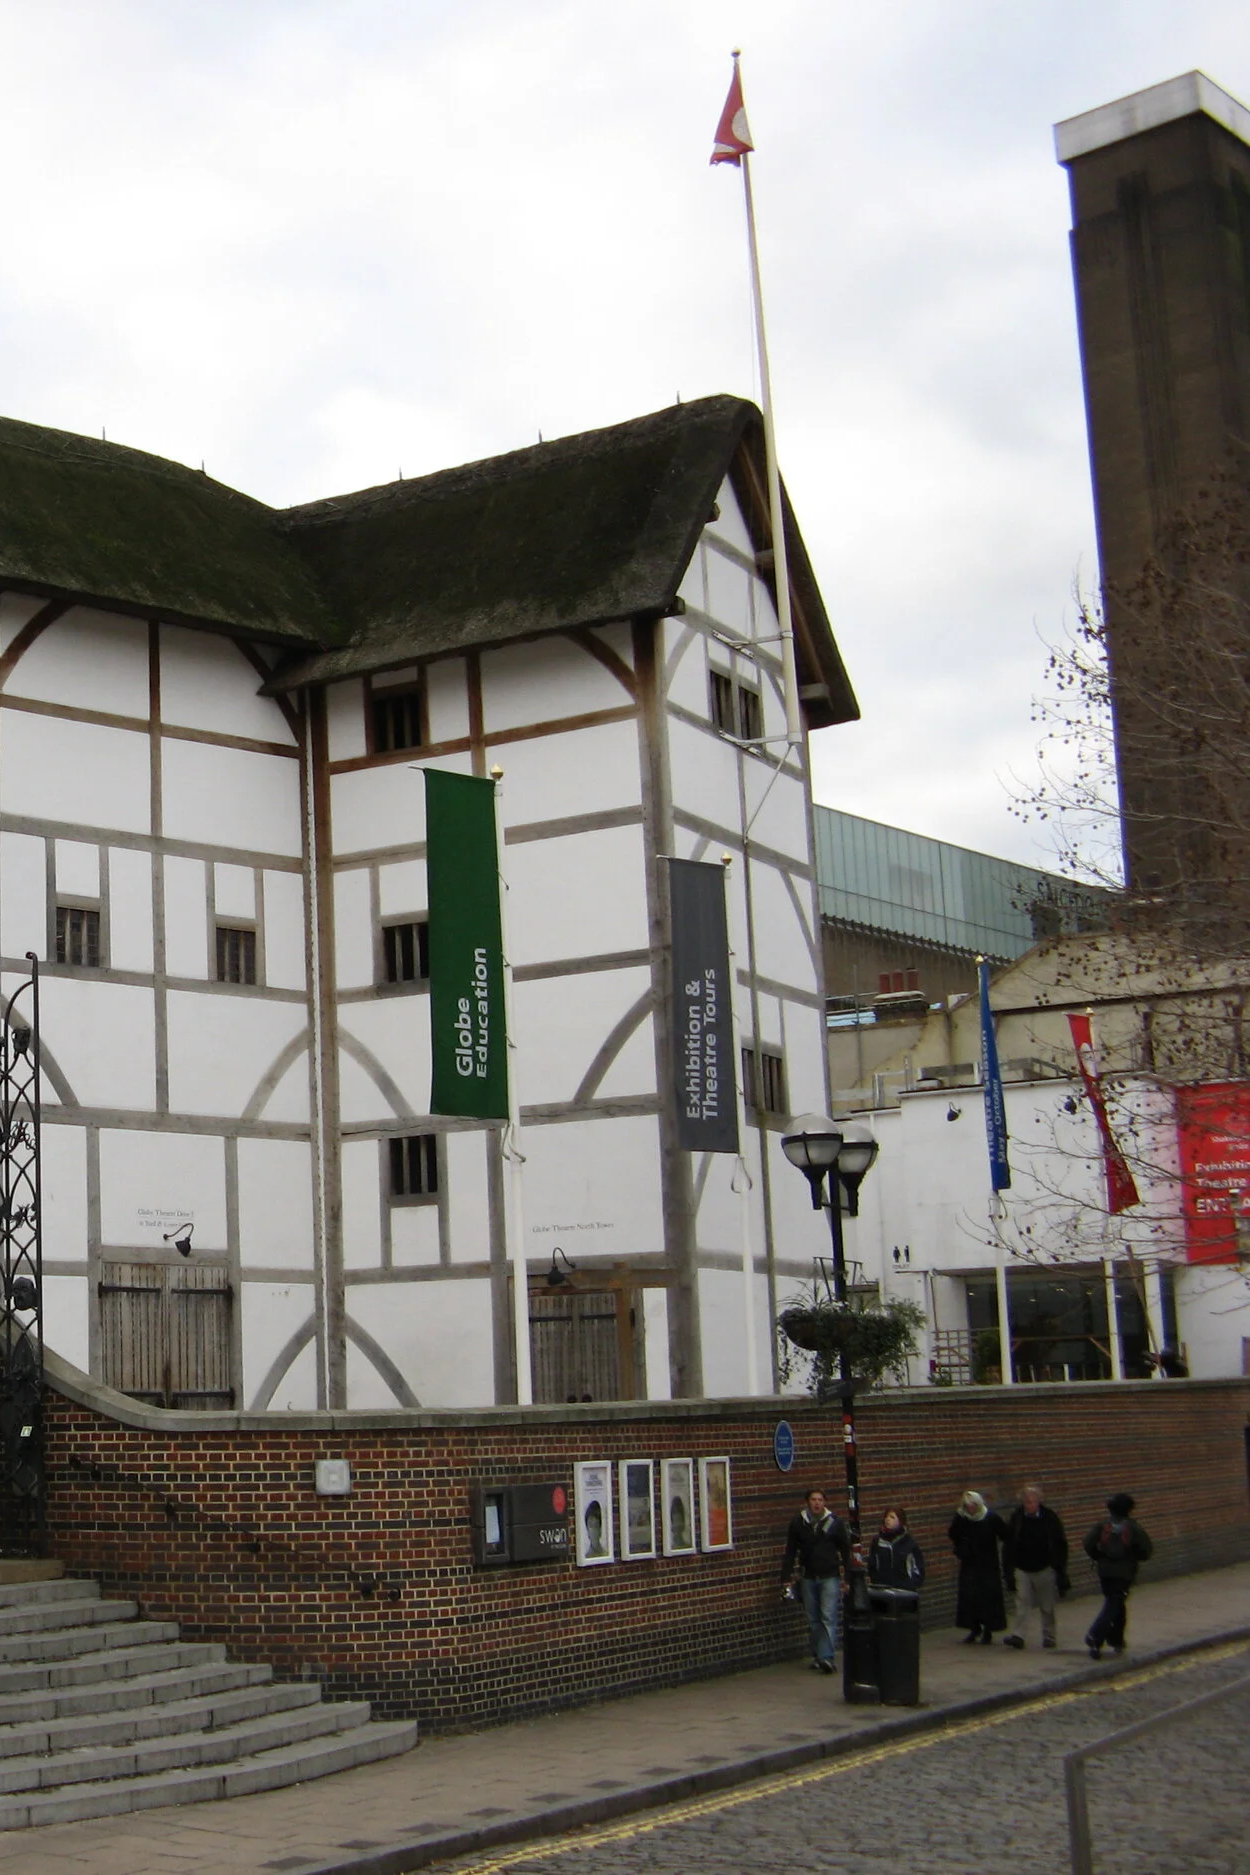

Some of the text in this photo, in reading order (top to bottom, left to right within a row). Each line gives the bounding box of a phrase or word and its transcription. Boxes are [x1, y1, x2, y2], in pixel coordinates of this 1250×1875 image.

[454, 997, 473, 1077] Globe
[471, 947, 487, 1078] Education
[684, 979, 701, 1119] Exhibition &
[702, 968, 719, 1121] Theatre Tours
